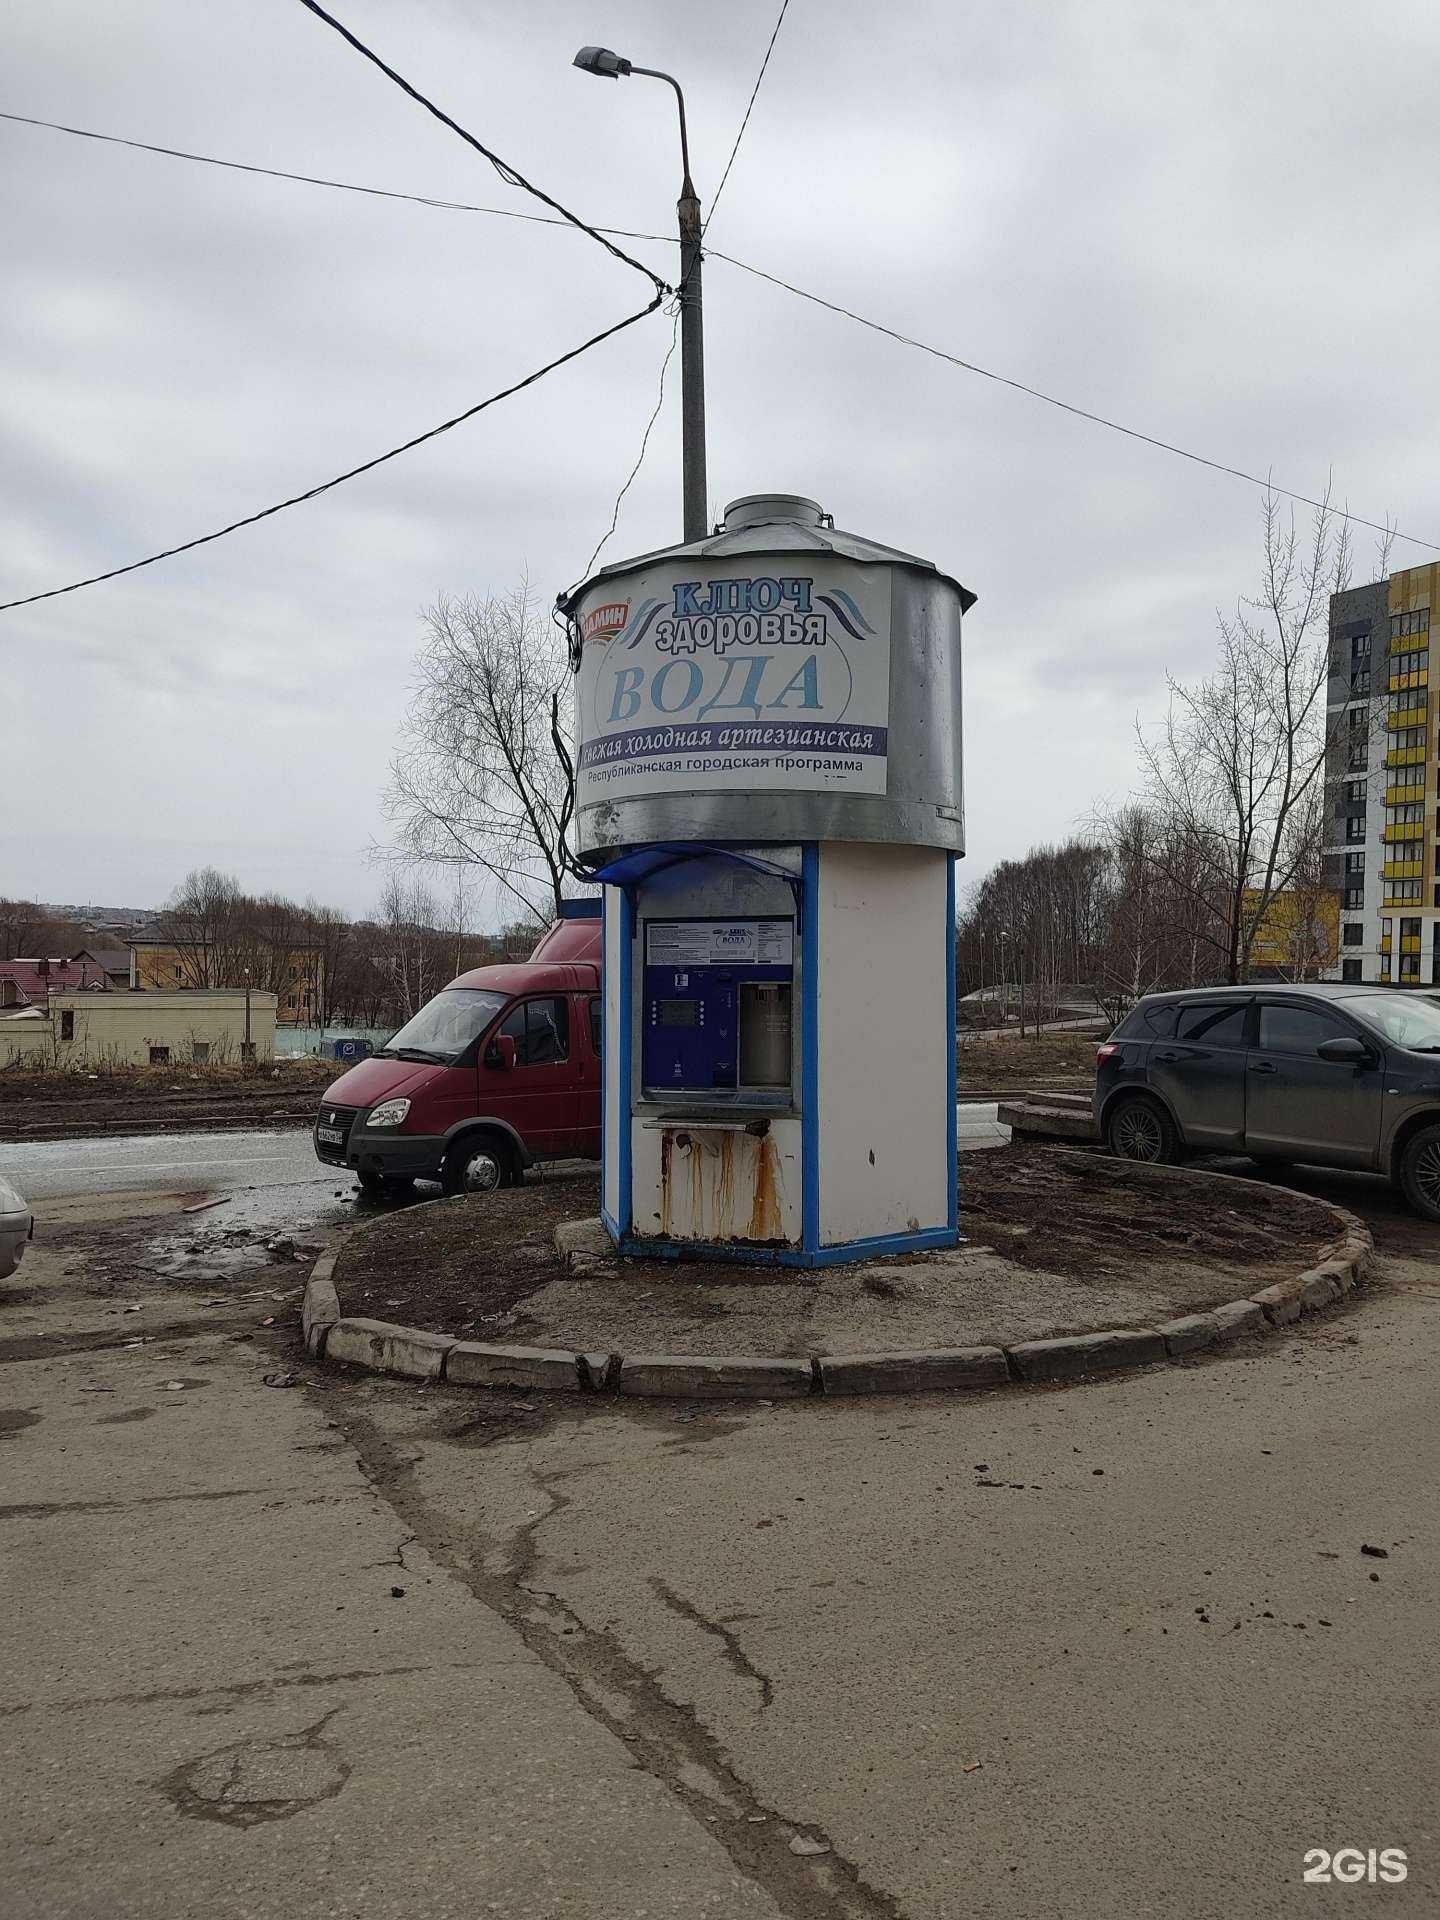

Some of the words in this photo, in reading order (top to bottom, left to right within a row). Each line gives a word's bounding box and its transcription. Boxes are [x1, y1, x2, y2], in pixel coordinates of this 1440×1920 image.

[672, 577, 813, 618] КЛЮЧ
[655, 613, 827, 655] ЗДОРОВЬЯ
[607, 655, 823, 722] ВОДА
[624, 727, 712, 755] холодная
[718, 727, 874, 750] артезианская
[588, 760, 681, 784] Республиканская
[686, 757, 769, 772] городская
[776, 758, 863, 772] программа
